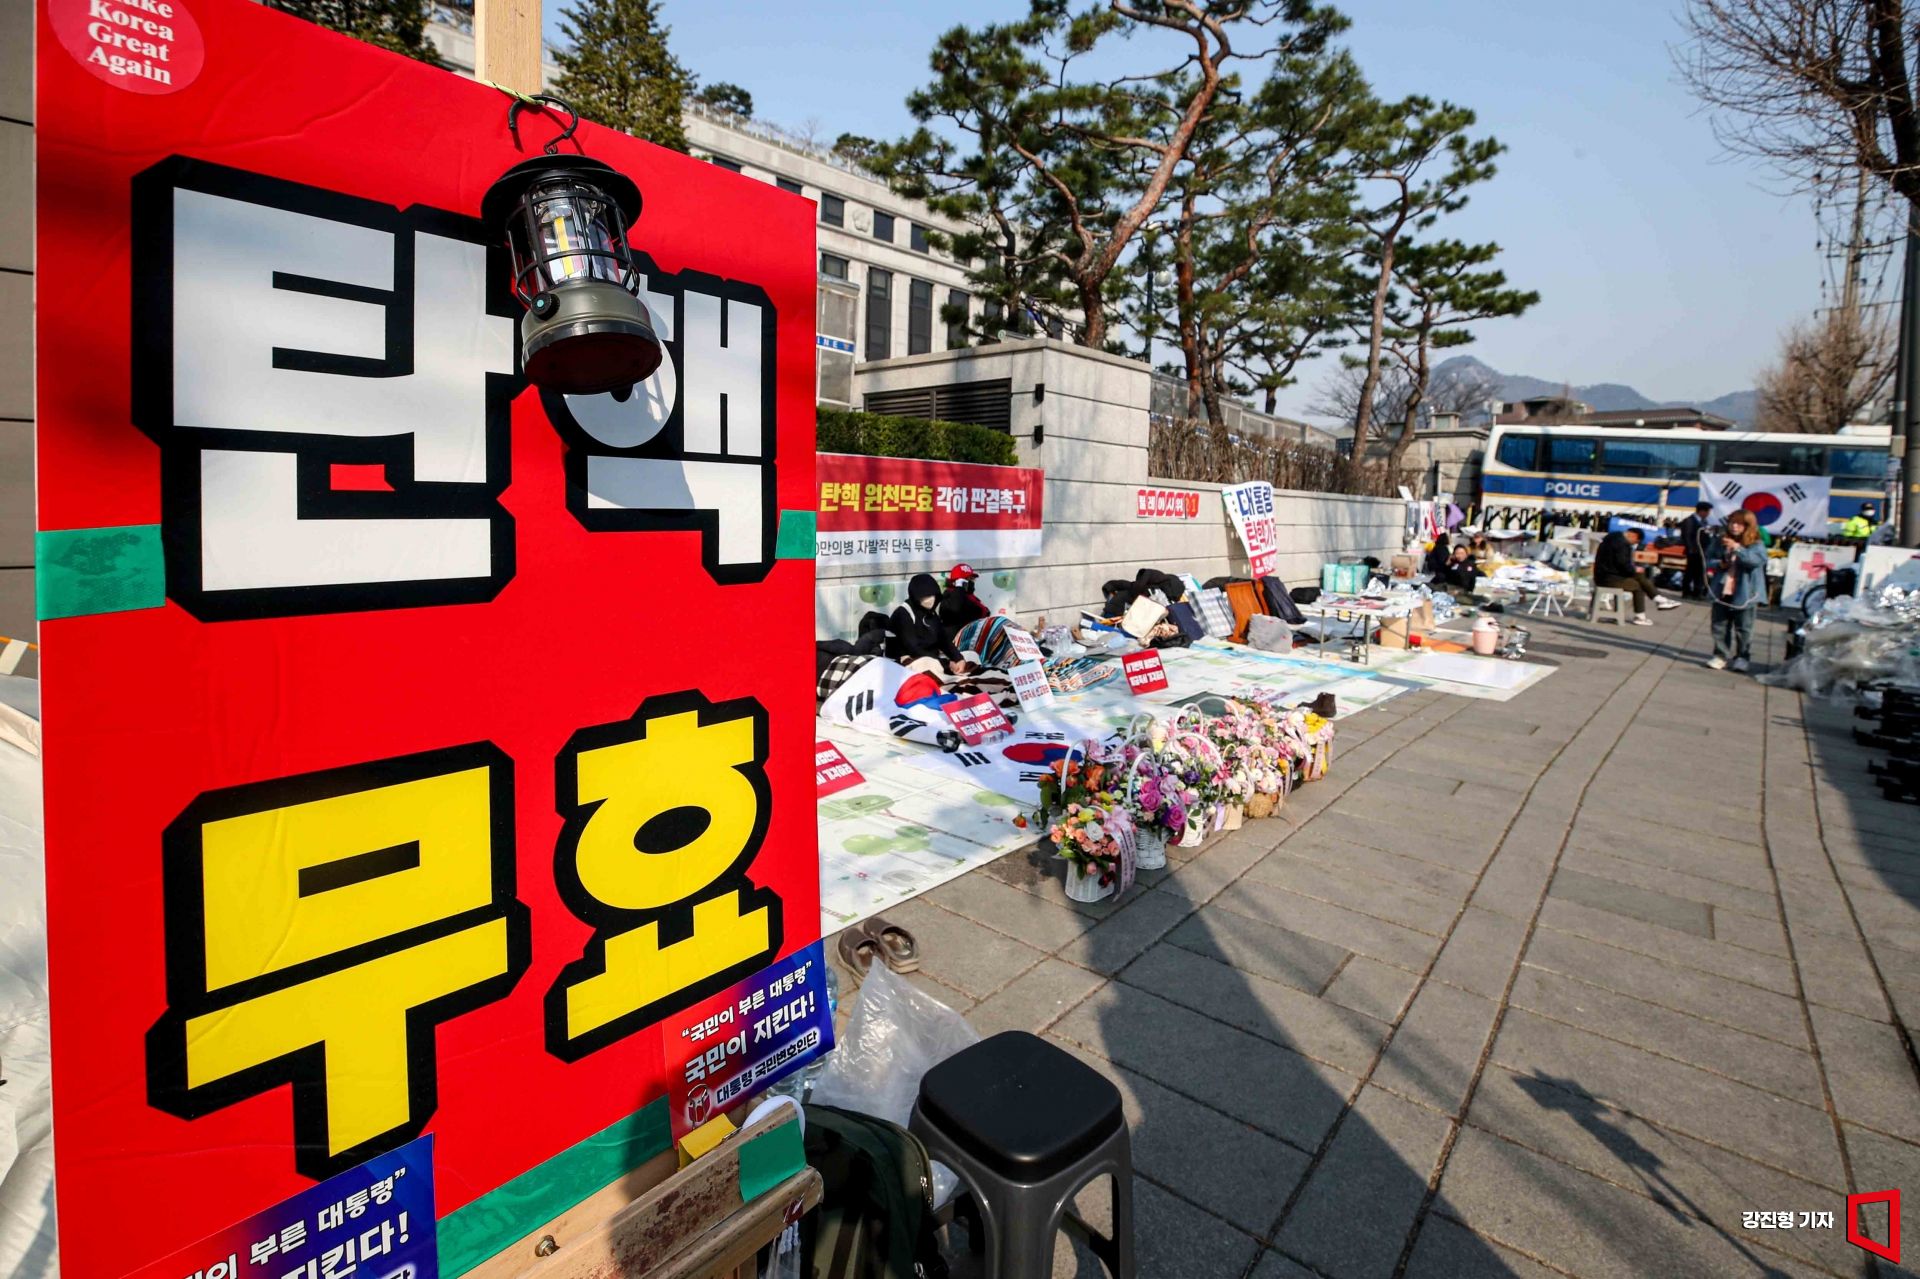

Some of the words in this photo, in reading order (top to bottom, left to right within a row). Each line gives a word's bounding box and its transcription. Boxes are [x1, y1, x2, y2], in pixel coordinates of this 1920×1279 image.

[88, 0, 175, 42] Korea
[114, 0, 173, 18] ake
[88, 22, 170, 62] Great
[87, 45, 172, 85] Again
[172, 186, 763, 592] 탄핵
[820, 482, 860, 512] 탄핵
[864, 483, 934, 513] 원천무효
[936, 487, 968, 513] 각하
[970, 488, 1026, 514] 판결촉구
[1545, 481, 1601, 497] POLICE
[857, 539, 889, 555] 자발적
[892, 539, 911, 553] 단식
[914, 538, 934, 552] 투쟁
[186, 710, 770, 1158] 무효
[682, 1006, 733, 1042] “국민이
[738, 989, 765, 1016] 부른
[769, 960, 812, 999] 대통령”
[685, 1030, 747, 1083] 국민이
[754, 991, 815, 1044] 지킨다!
[716, 1069, 753, 1104] 대통령
[755, 1031, 817, 1078] 국민변호인단
[250, 1219, 307, 1266] 부른
[318, 1167, 406, 1232] 대통령”
